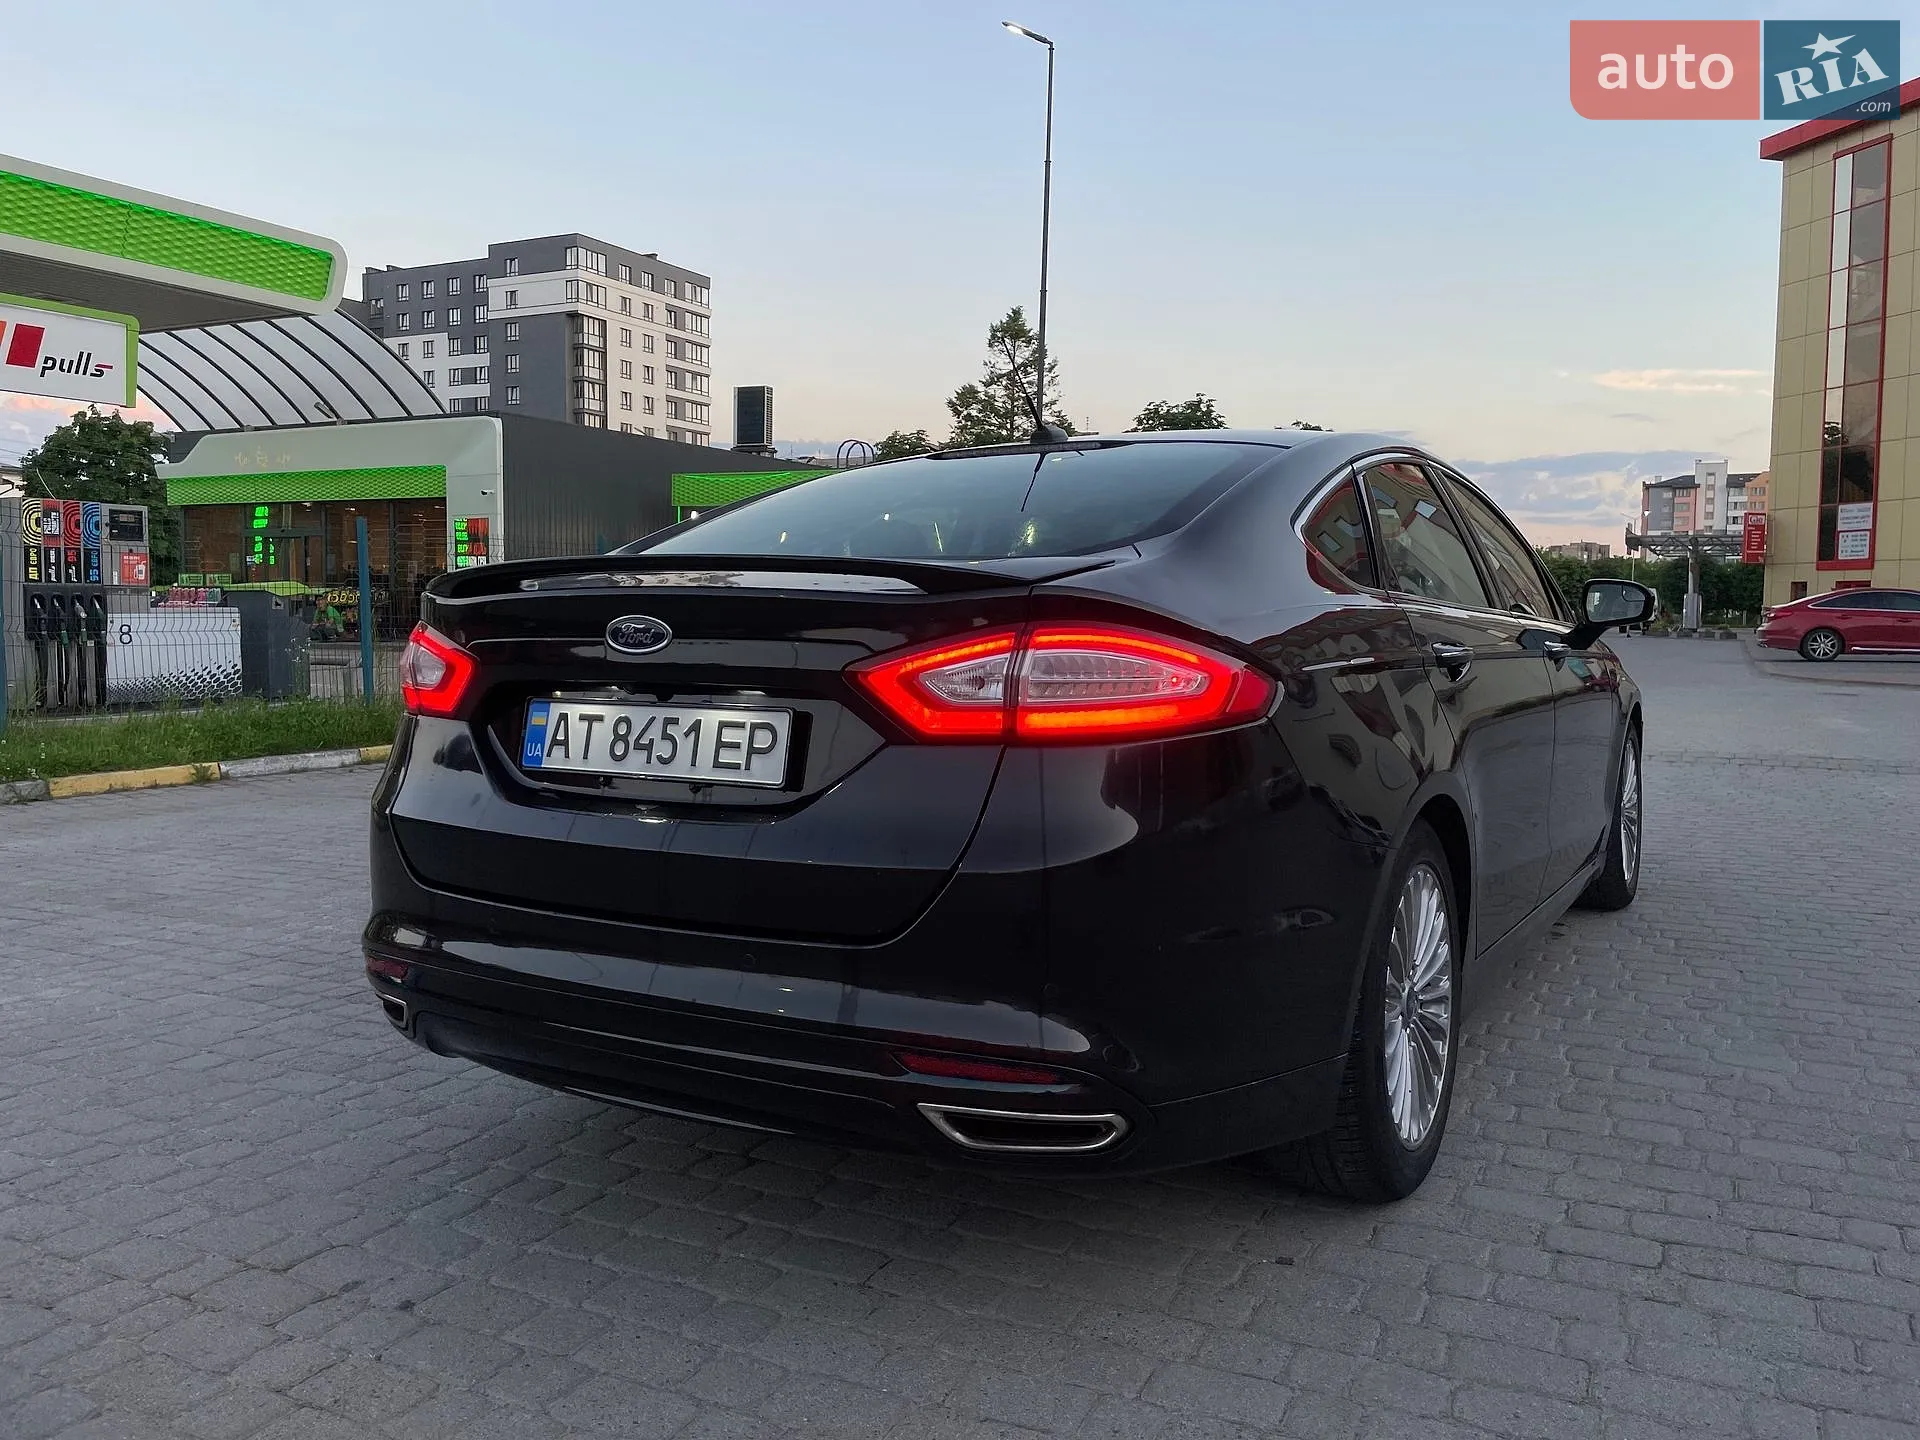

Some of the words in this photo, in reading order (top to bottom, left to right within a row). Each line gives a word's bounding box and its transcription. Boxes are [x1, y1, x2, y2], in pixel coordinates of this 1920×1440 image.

[40, 351, 113, 378] pulls
[119, 624, 132, 645] 8
[617, 623, 655, 644] Ford
[527, 742, 542, 757] UA
[546, 712, 605, 760] AT
[609, 715, 702, 766] 8451
[712, 720, 778, 771] EP
